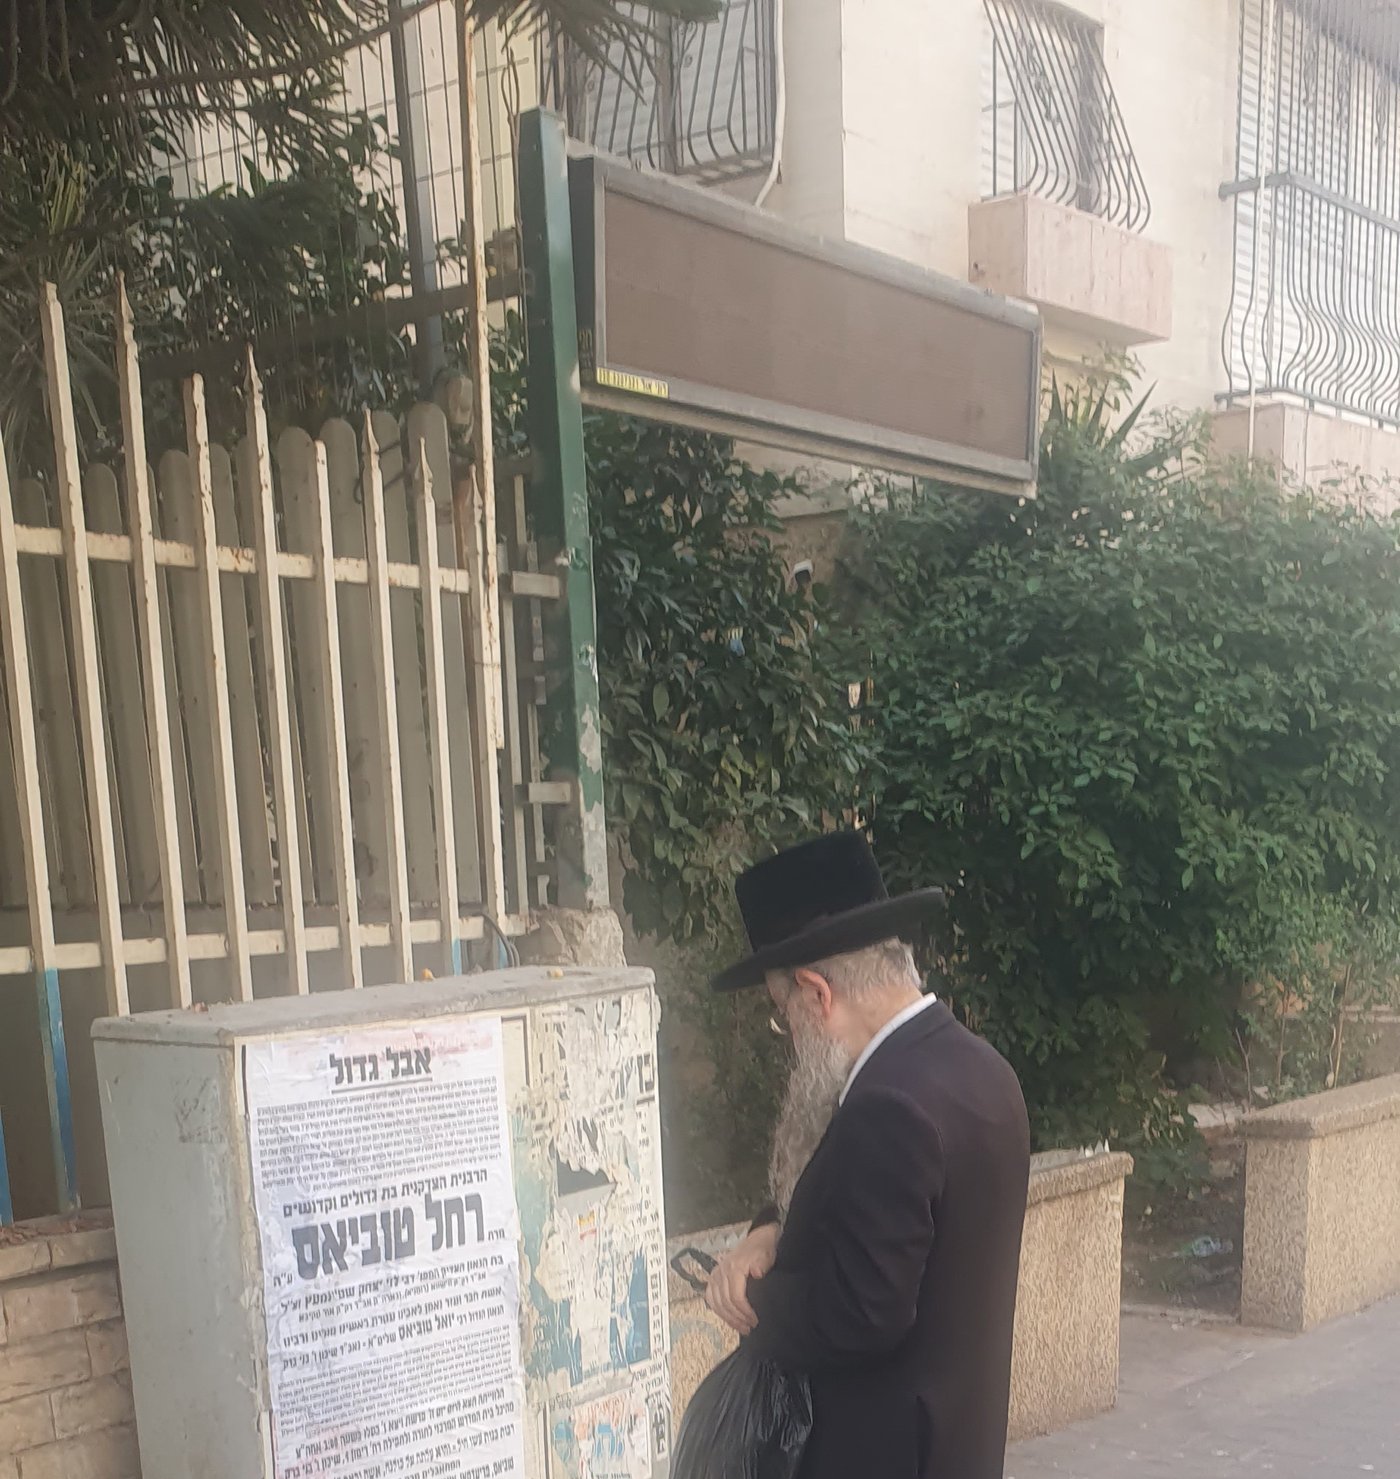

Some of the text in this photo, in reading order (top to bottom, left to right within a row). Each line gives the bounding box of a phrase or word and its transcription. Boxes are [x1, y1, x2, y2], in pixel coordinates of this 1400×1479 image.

[329, 1047, 431, 1085] אבל גדול
[283, 1169, 487, 1217] הרבנית הצדקנית בת גדולים וקדושים
[273, 1193, 505, 1287] מרת רחל טוביאס ע"ה
[467, 1258, 488, 1272] הגאון
[491, 1255, 503, 1266] בת
[441, 1263, 465, 1279] הצדיק
[401, 1274, 415, 1284] רבי
[358, 1280, 383, 1297] יצחק
[481, 1286, 501, 1299] אשת
[464, 1292, 479, 1303] חבר
[424, 1300, 442, 1314] נאמן
[487, 1305, 504, 1319] הגאון
[435, 1313, 454, 1330] יואל
[398, 1319, 432, 1340] טוביאס
[283, 1333, 308, 1347] ורבינו
[462, 1396, 477, 1410] תצא
[495, 1401, 514, 1416] מהיכל
[457, 1411, 481, 1428] המדרש
[482, 1407, 494, 1421] בית
[388, 1417, 404, 1432] ויצא
[434, 1418, 456, 1434] המרכזי
[412, 1424, 433, 1442] לתורה
[484, 1429, 499, 1444] בנות
[302, 1462, 313, 1475] בני
